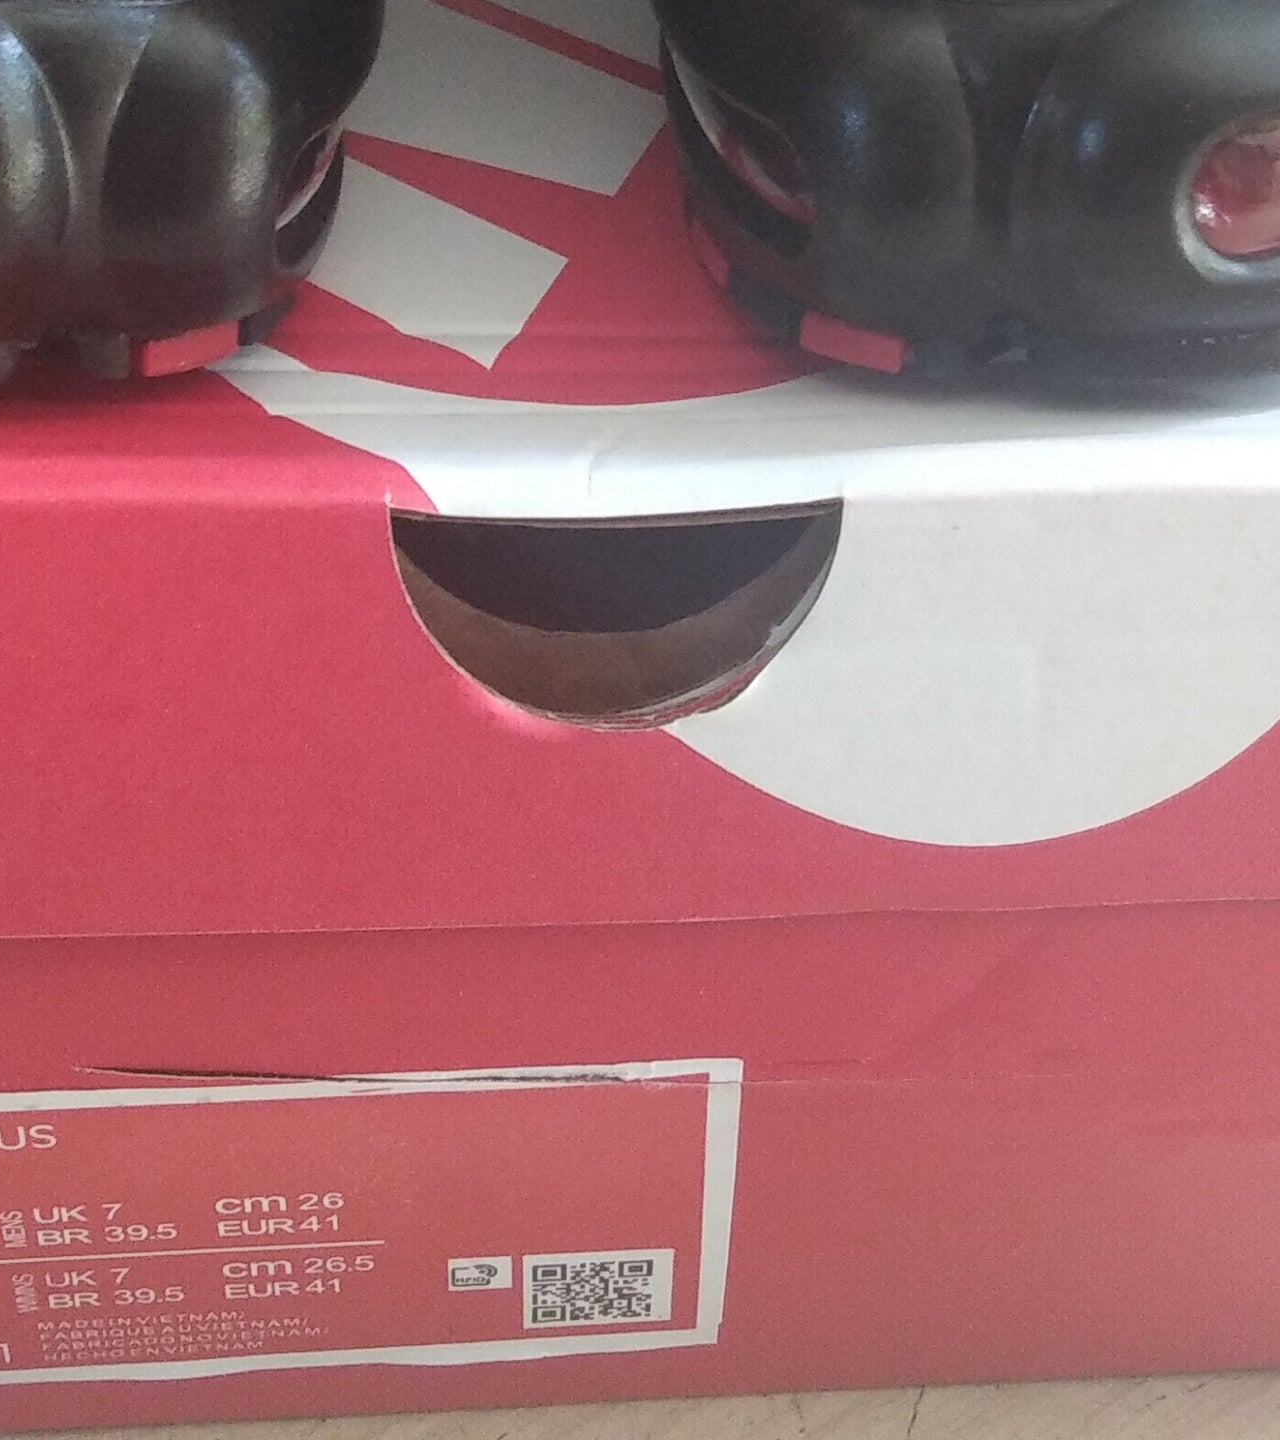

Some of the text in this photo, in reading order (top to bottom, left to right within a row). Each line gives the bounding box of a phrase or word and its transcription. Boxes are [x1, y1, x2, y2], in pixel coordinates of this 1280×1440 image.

[32, 1203, 122, 1224] UK 7
[214, 1191, 346, 1215] cm 26
[0, 1210, 28, 1248] MENS
[36, 1223, 178, 1247] BR 39.5
[217, 1214, 340, 1237] EUR 41
[45, 1267, 131, 1288] UK 7
[221, 1254, 376, 1278] cm 26.5
[47, 1285, 186, 1310] BR 39.5
[224, 1277, 342, 1300] EUR 41
